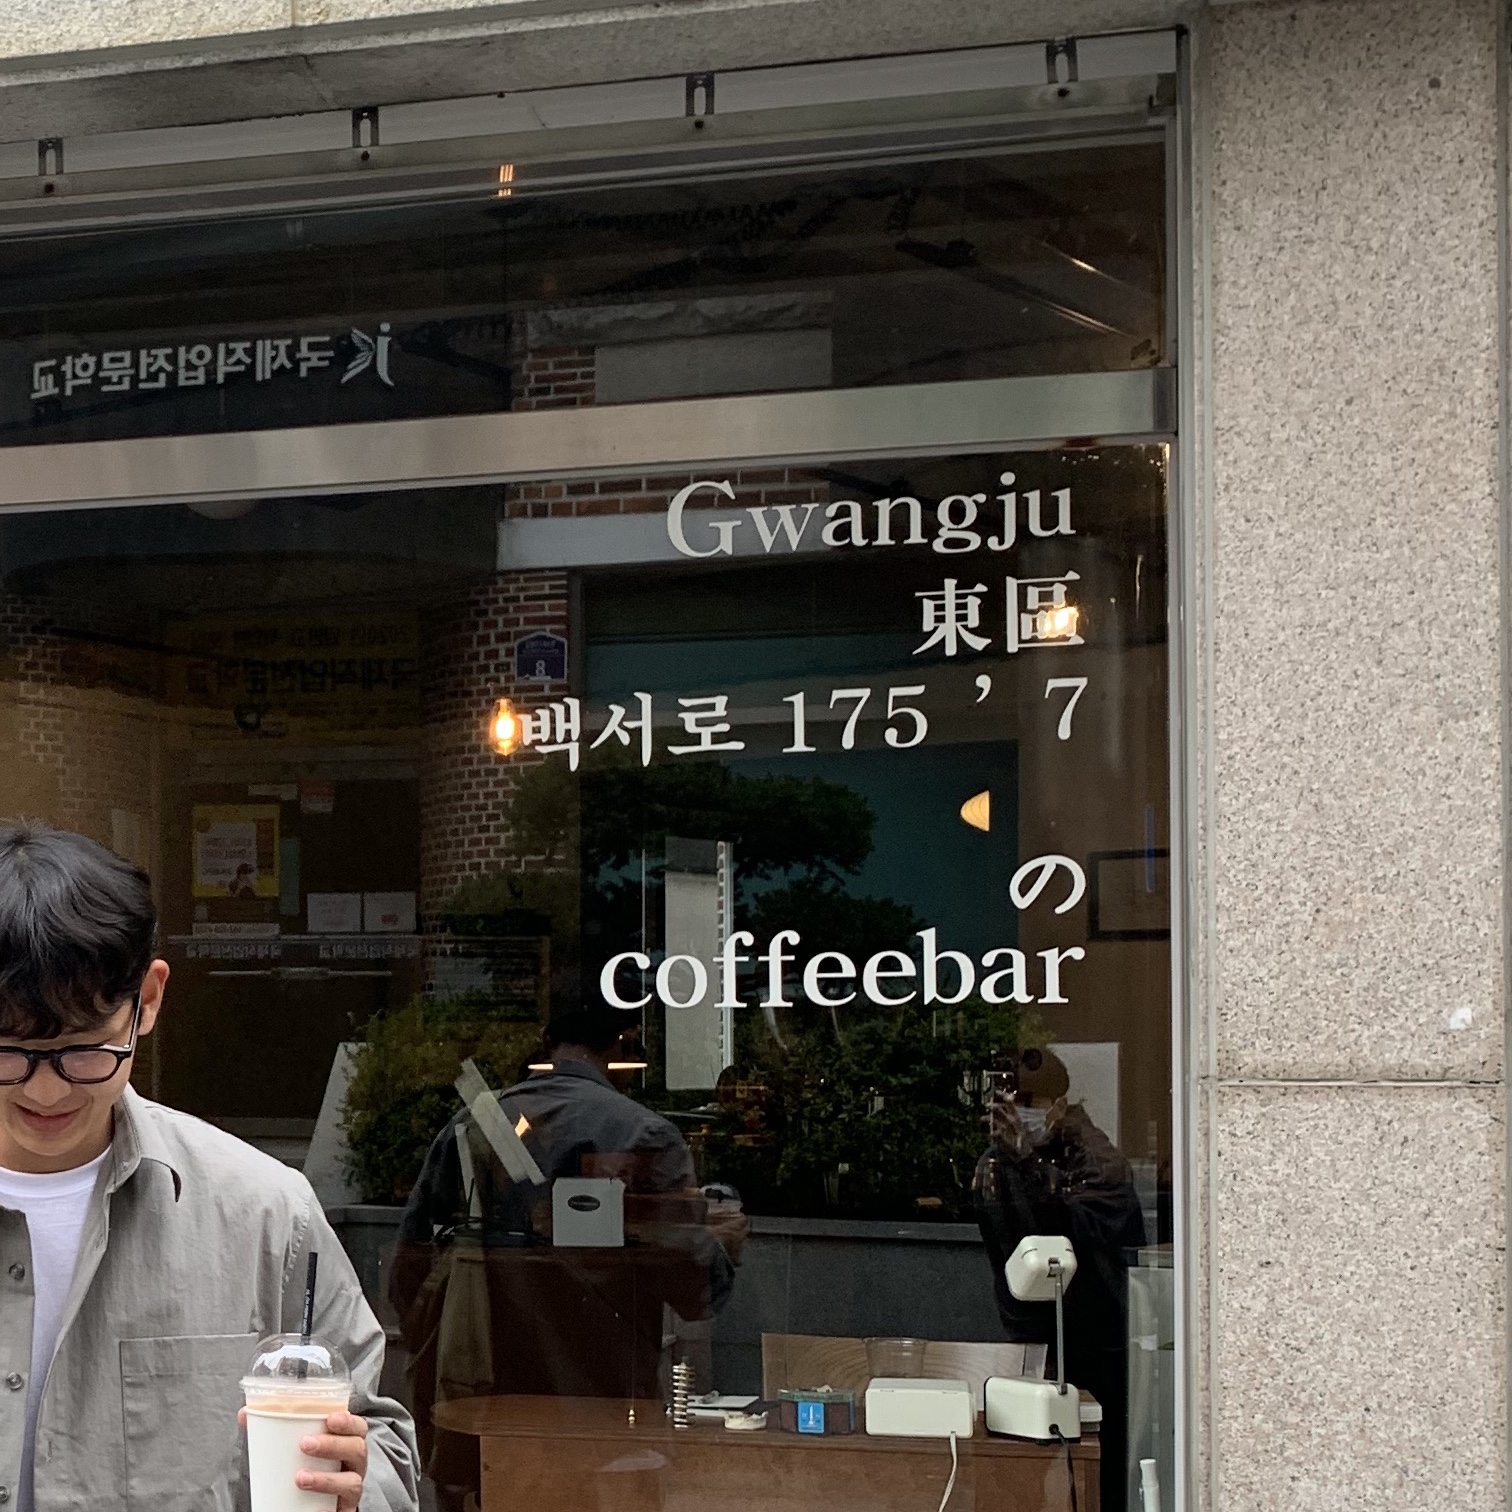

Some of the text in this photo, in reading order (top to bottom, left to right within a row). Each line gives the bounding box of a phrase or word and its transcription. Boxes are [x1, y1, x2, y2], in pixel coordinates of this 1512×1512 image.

[667, 472, 1076, 557] Gwangju
[912, 570, 1085, 656] 東區
[518, 691, 746, 772] 백서로
[782, 685, 929, 754] 175
[1044, 677, 1089, 740] 7
[1009, 855, 1087, 914] の
[600, 927, 1086, 1011] coffeebar
